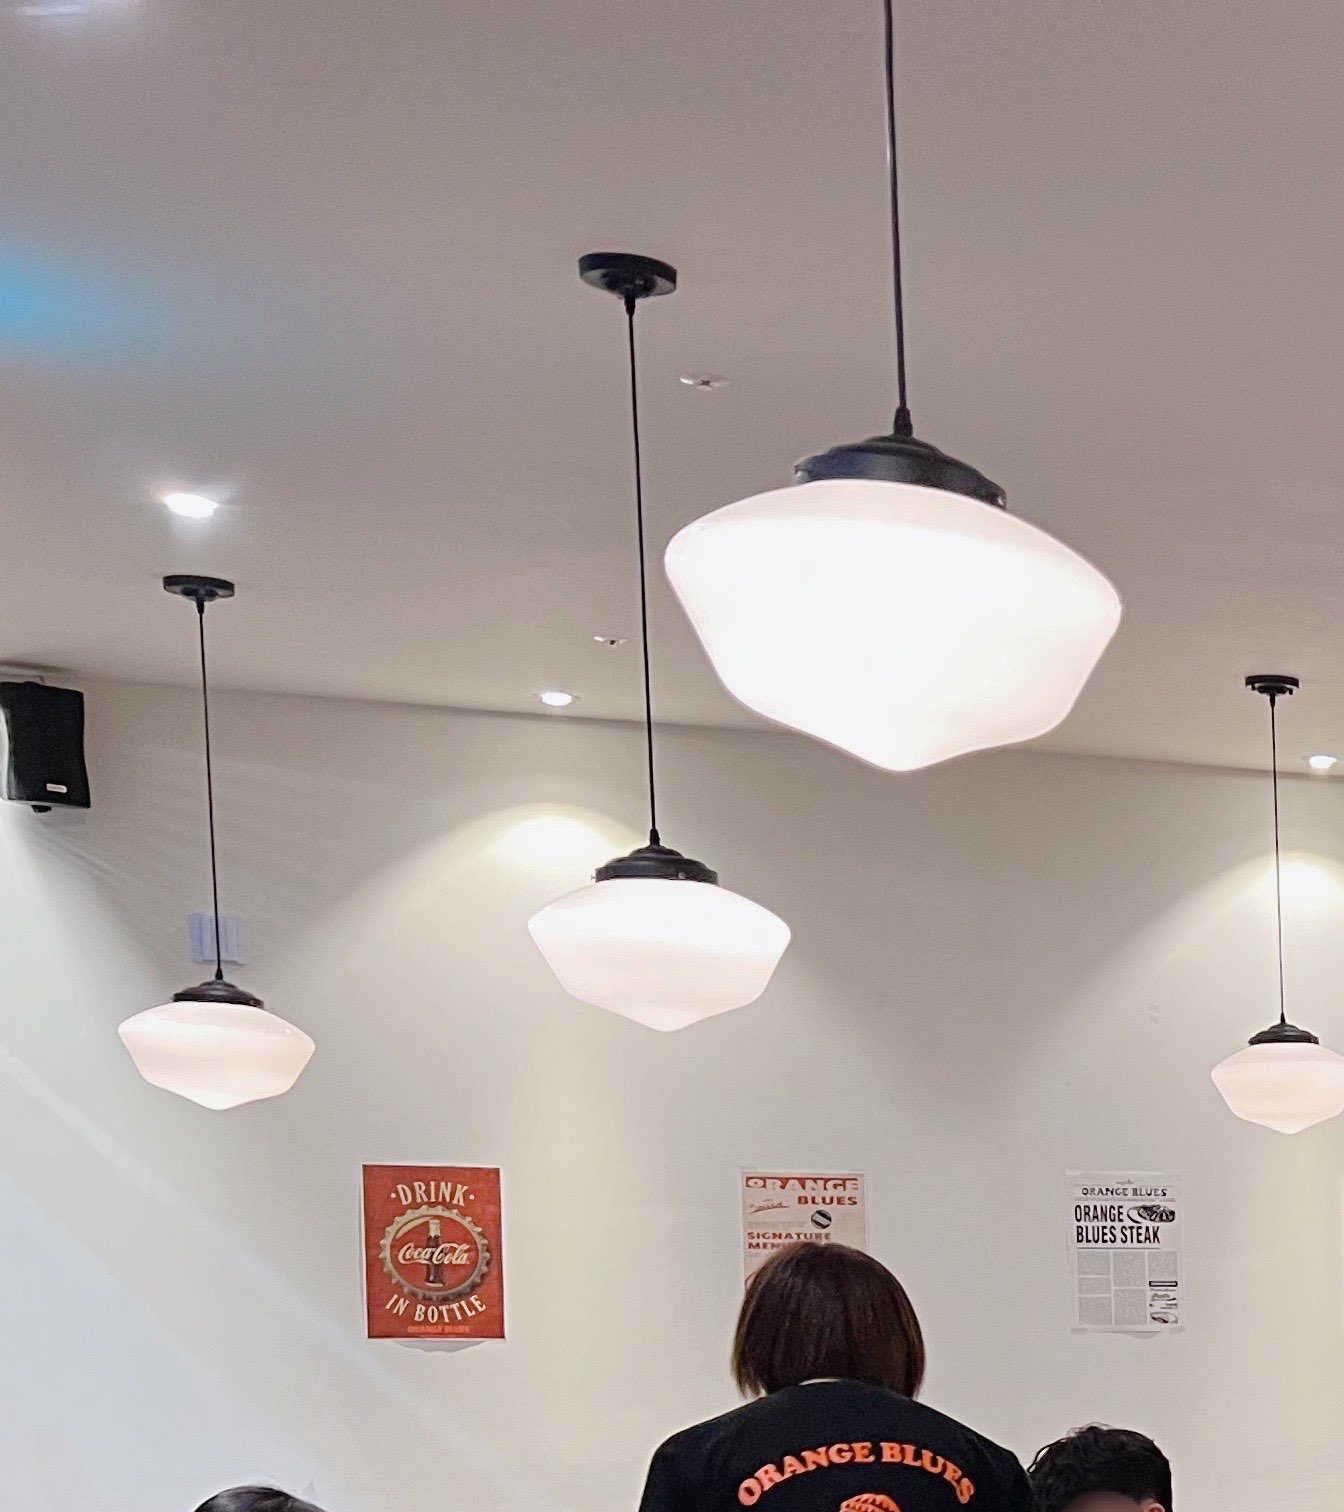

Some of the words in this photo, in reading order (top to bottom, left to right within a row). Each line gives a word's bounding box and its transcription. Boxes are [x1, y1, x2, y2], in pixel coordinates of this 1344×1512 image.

[749, 1178, 859, 1191] ORANGE
[1081, 1187, 1129, 1197] ORANGE
[1132, 1188, 1168, 1197] BLUES
[396, 1181, 470, 1206] DRINK
[797, 1195, 858, 1206] BLUES
[1074, 1204, 1124, 1223] ORANGE
[747, 1231, 832, 1240] SIGNATURE
[1076, 1225, 1117, 1244] BLUES
[1120, 1225, 1161, 1244] STEAK
[748, 1241, 782, 1250] MEN
[385, 1294, 410, 1316] IN
[414, 1294, 487, 1323] BOTTLE
[737, 1442, 875, 1506] ORANGE
[879, 1442, 975, 1504] BLUES
